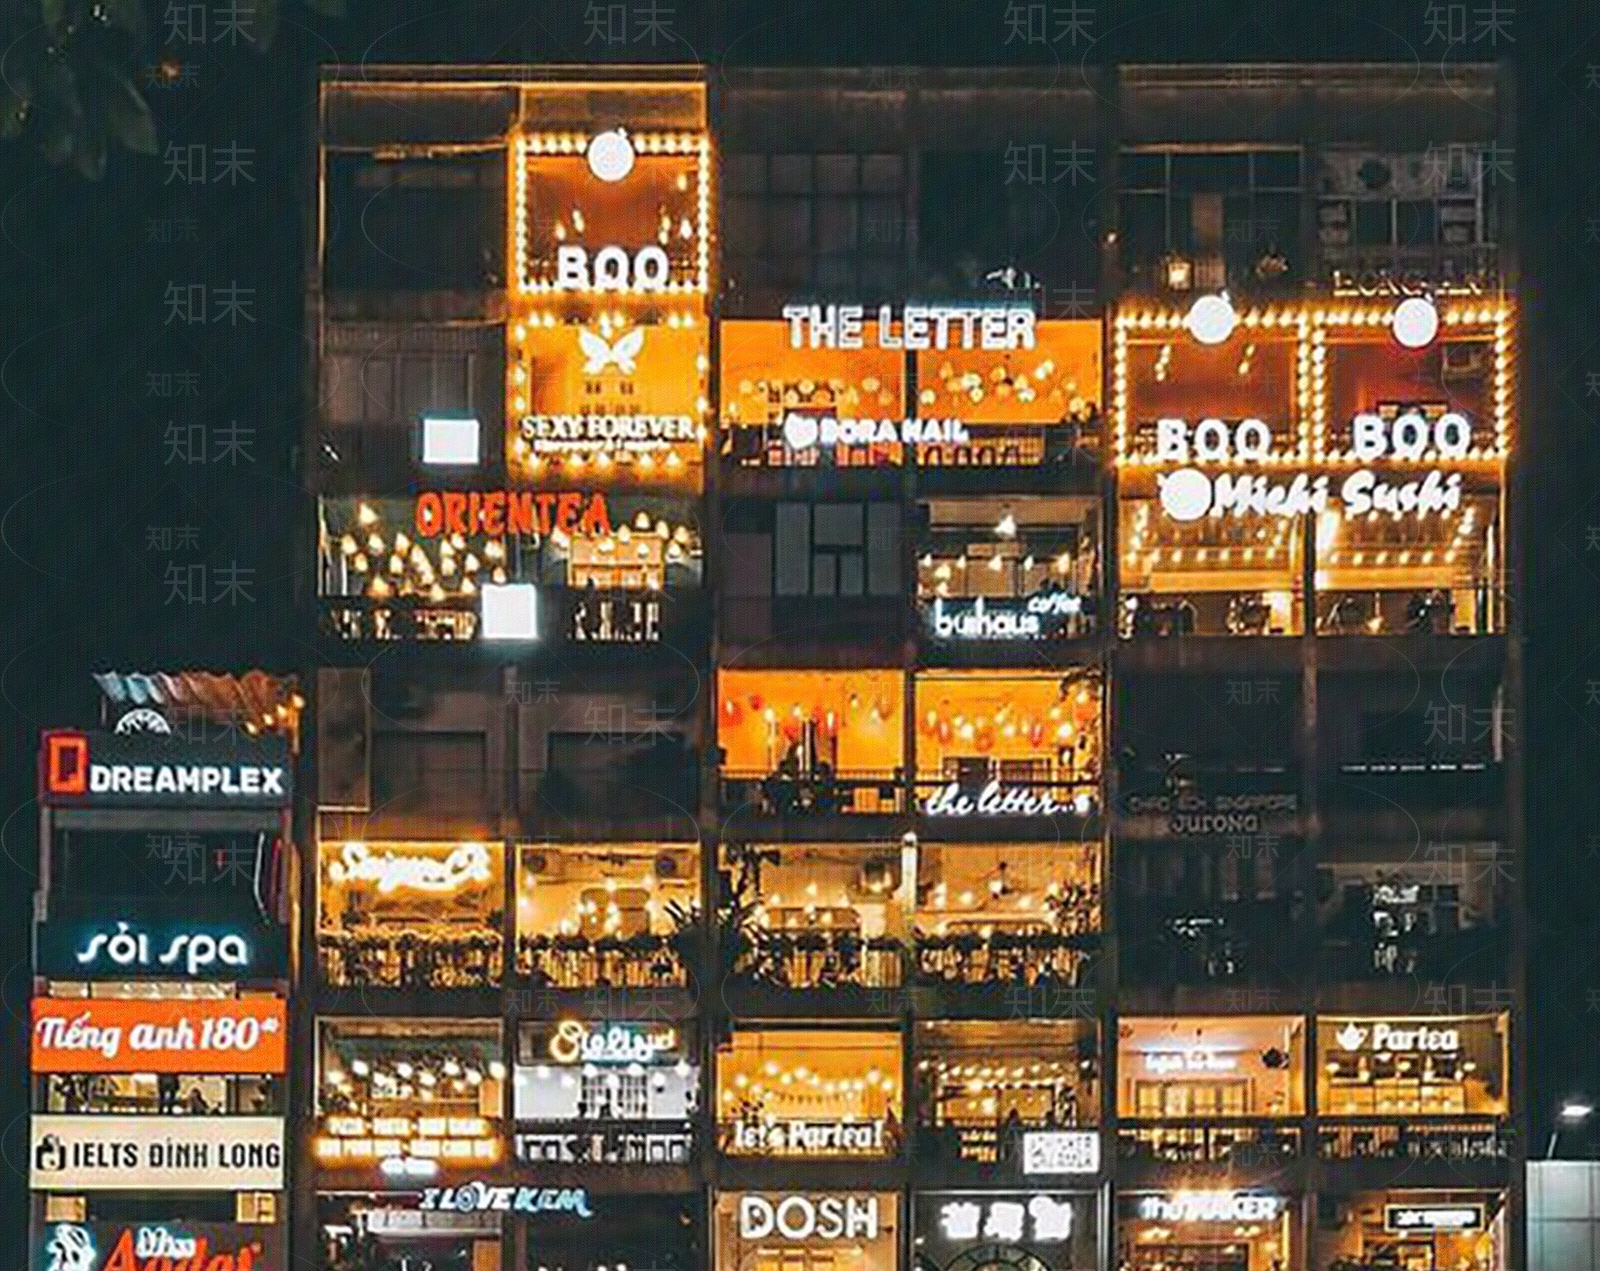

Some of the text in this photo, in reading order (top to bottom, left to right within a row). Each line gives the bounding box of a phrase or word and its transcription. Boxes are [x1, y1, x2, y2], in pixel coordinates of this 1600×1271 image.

[555, 247, 670, 290] BOO
[783, 306, 1036, 350] THE LETTER
[1157, 418, 1272, 461] BOO
[1353, 413, 1471, 460] BOO
[415, 492, 610, 536] ORIENTEA
[90, 766, 284, 793] DREAMPLEX
[159, 934, 249, 975] spa
[36, 1010, 121, 1058] Tiếng
[130, 1018, 194, 1050] anh
[73, 1143, 139, 1168] IELTS
[218, 1143, 281, 1168] LONG
[740, 1197, 878, 1239] DOSH
